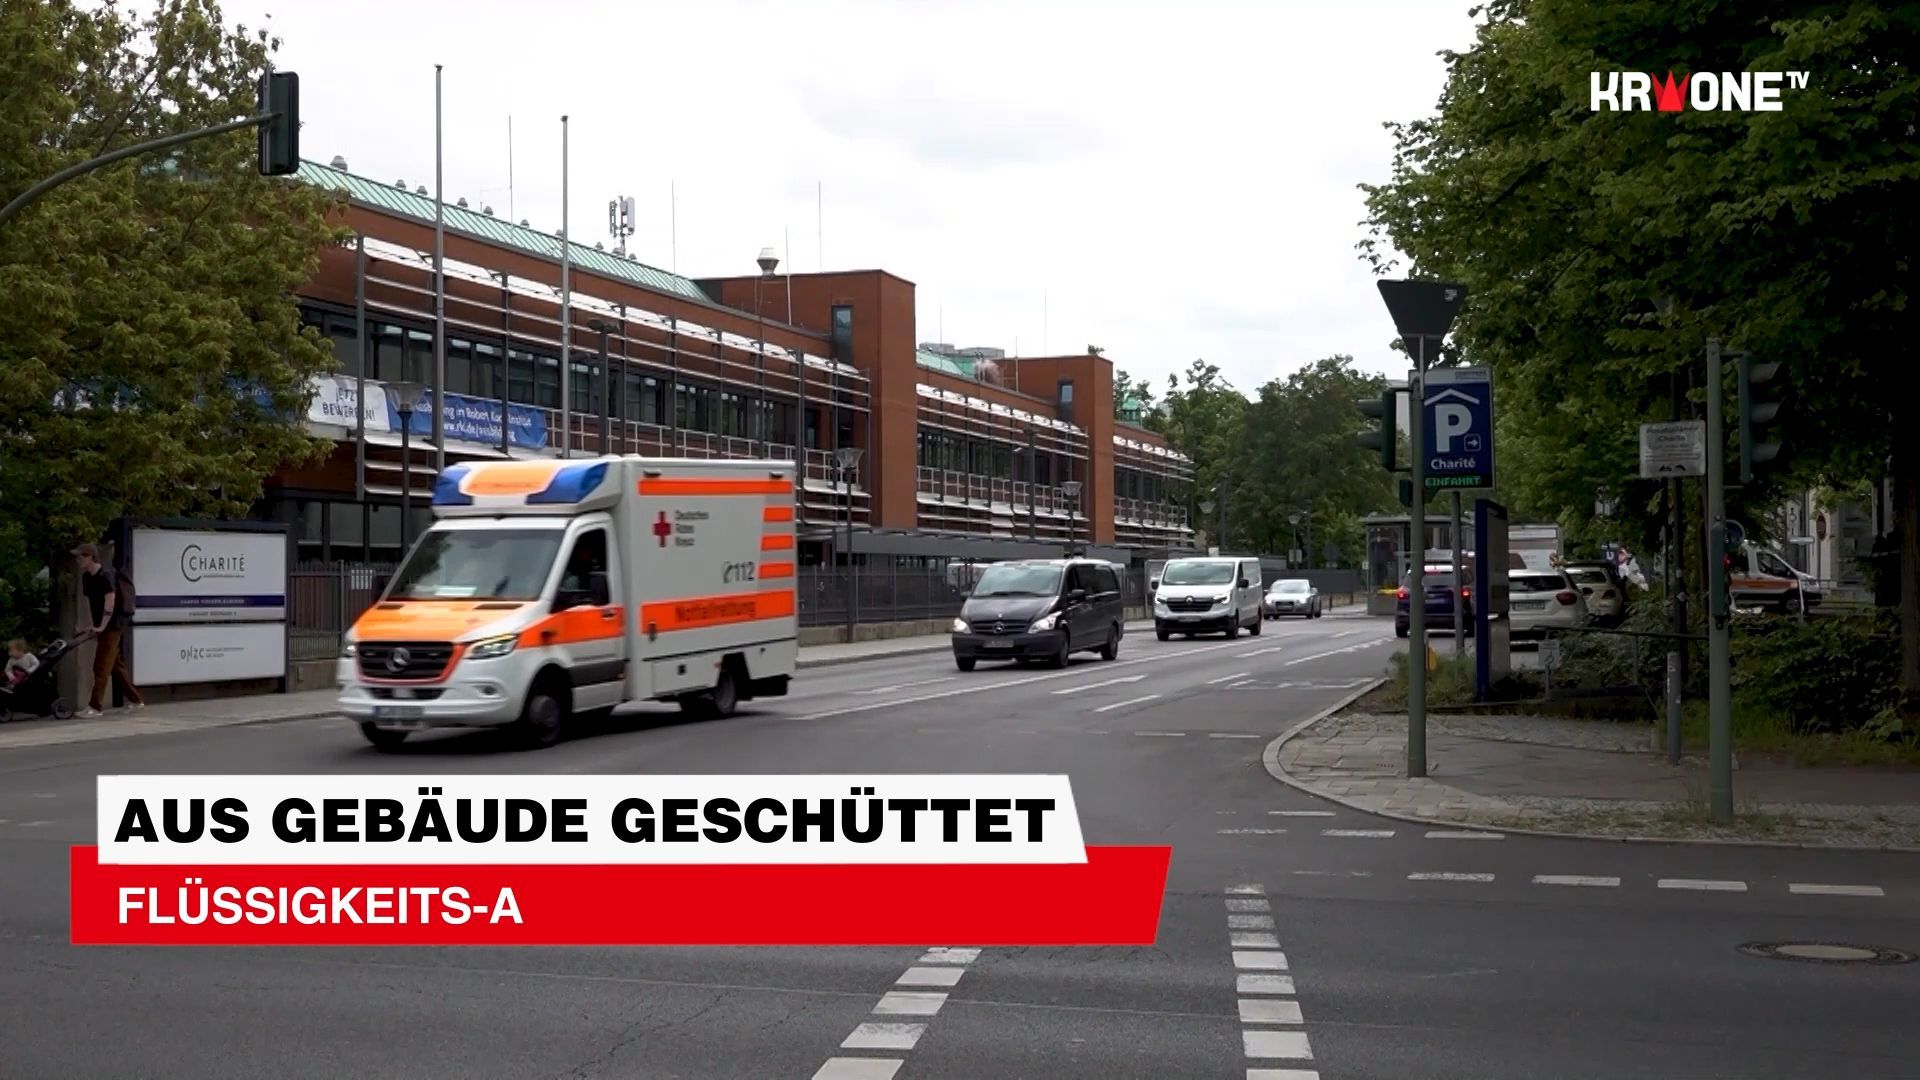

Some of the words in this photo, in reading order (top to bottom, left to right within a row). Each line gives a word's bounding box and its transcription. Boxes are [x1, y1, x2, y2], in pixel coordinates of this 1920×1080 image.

[336, 386, 358, 402] JETZ
[1435, 403, 1472, 453] P
[1430, 458, 1476, 470] Charité
[1424, 476, 1481, 487] EINFAHRT
[188, 553, 246, 572] CHARITÉ
[733, 561, 755, 581] 112
